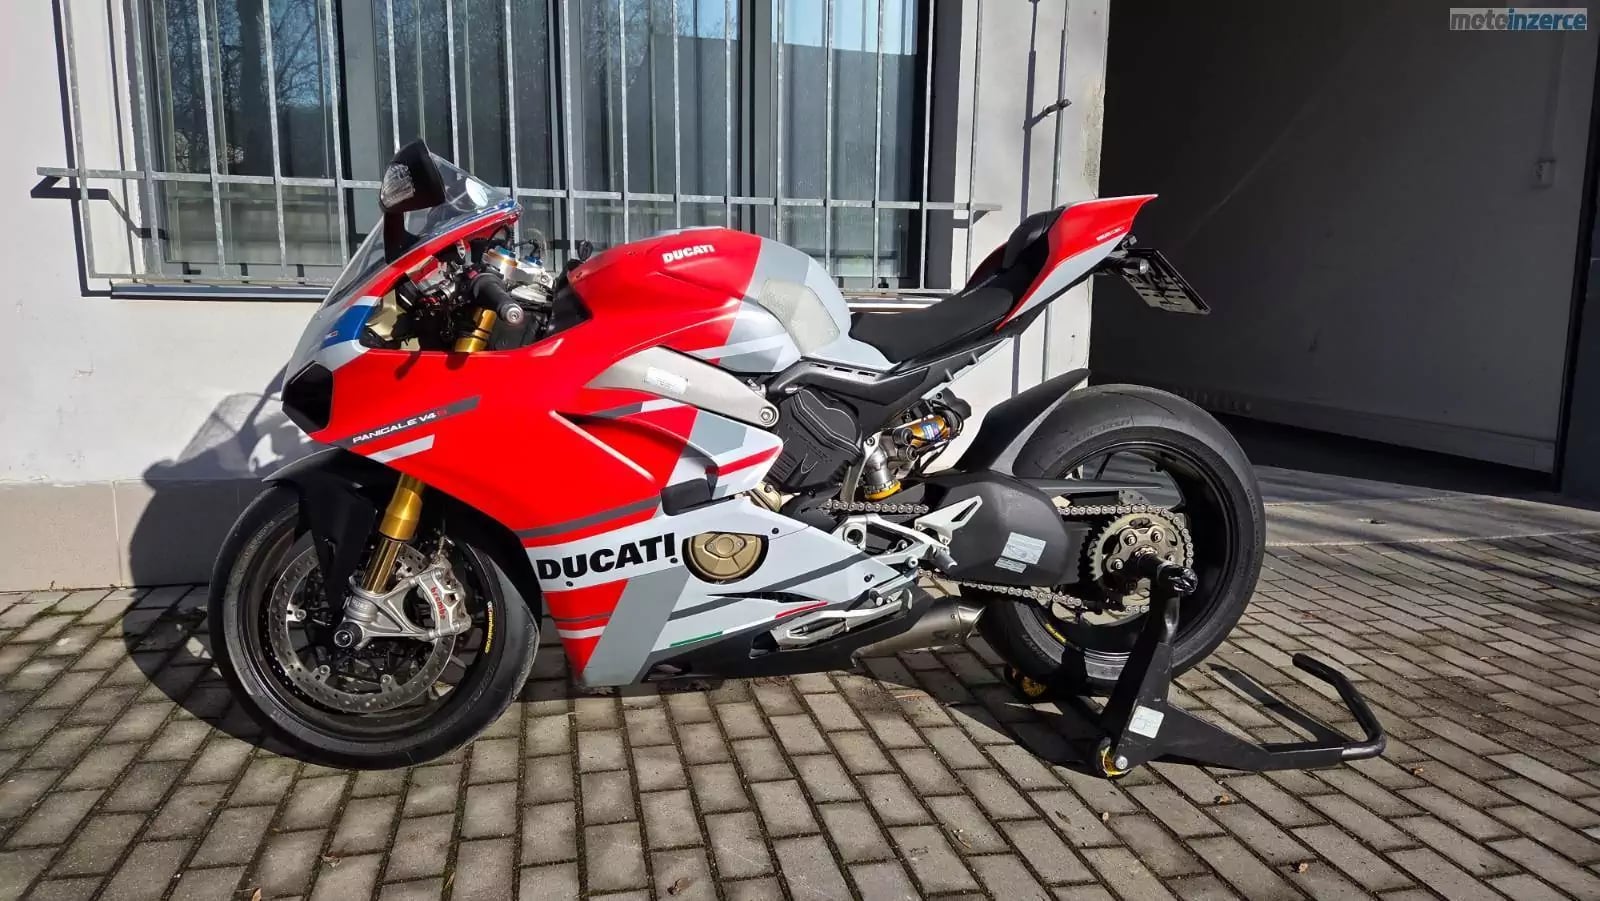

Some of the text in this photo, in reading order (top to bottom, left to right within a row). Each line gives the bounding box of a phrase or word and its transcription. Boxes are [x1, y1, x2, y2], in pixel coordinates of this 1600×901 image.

[662, 244, 715, 264] DUCATI
[535, 532, 676, 580] DUCATI
[430, 586, 447, 620] brembo
